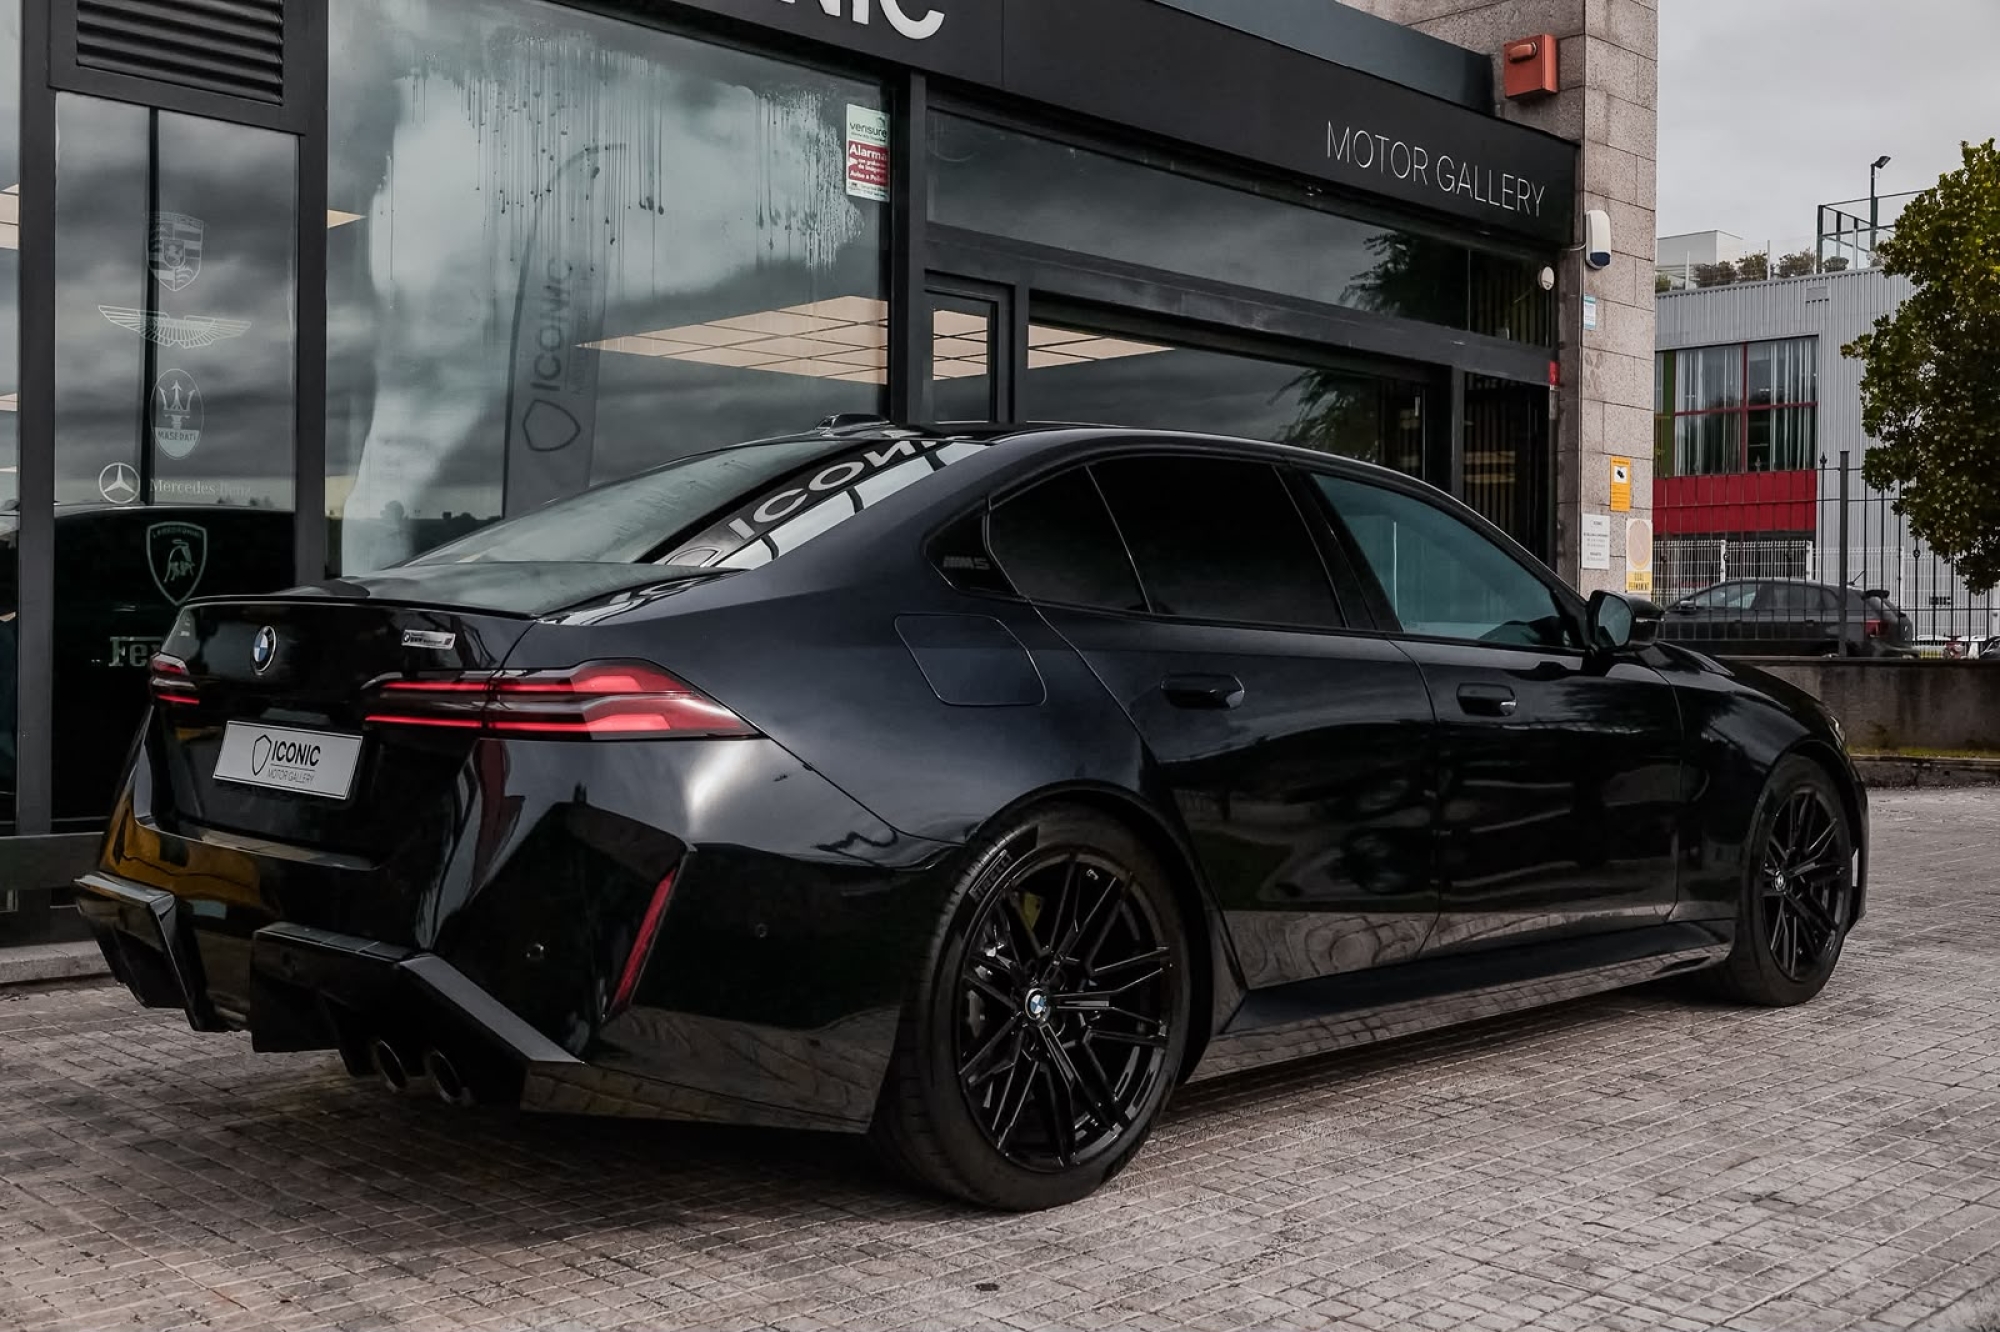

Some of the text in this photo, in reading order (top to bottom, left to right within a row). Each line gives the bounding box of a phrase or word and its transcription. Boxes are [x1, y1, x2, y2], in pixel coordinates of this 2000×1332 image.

[1326, 120, 1545, 217] MOTOR GALLERY
[529, 258, 572, 392] ICONIC
[158, 431, 197, 442] MASERATI
[149, 479, 251, 498] Mercedes-Benz
[272, 740, 321, 767] ICONIC
[269, 768, 315, 785] MOTOR GALLERY
